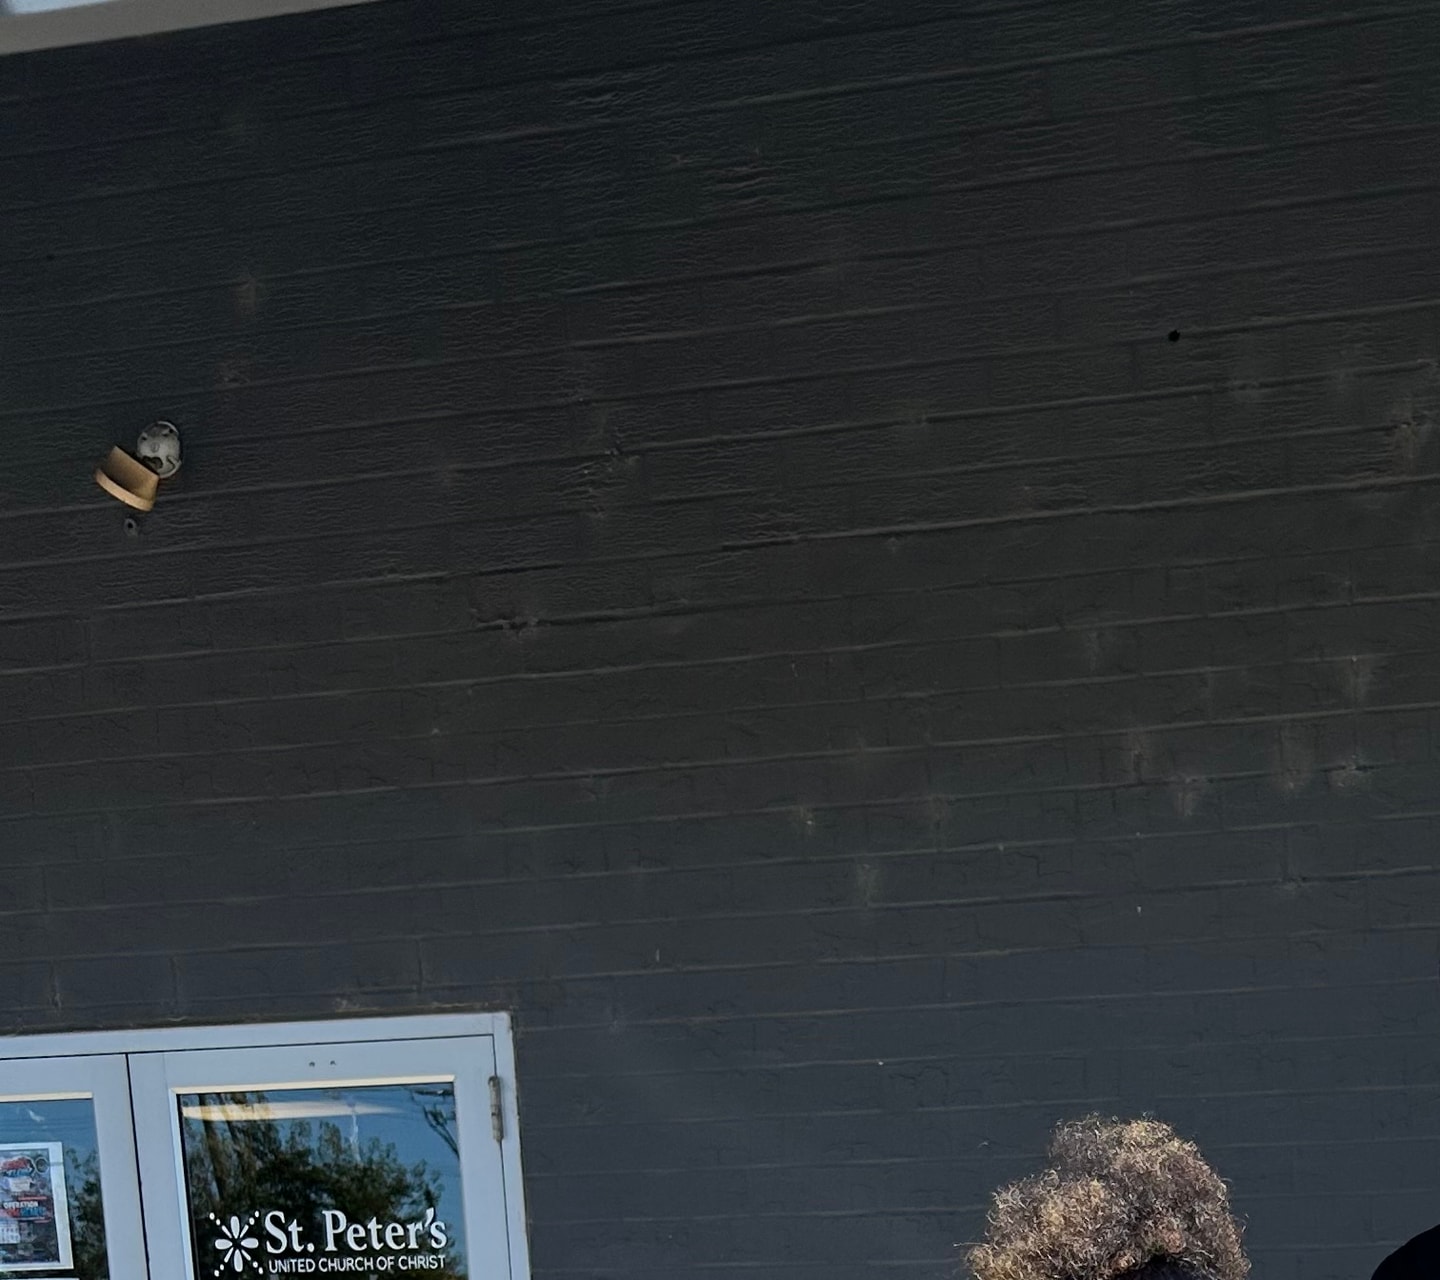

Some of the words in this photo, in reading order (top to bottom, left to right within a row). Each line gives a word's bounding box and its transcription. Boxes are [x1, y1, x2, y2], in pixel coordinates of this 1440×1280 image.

[264, 1210, 315, 1254] St.
[322, 1207, 448, 1252] Peter's
[268, 1257, 316, 1273] UNITED
[318, 1256, 374, 1272] CHURCH
[376, 1255, 394, 1271] OF
[398, 1254, 446, 1270] CHRIST
